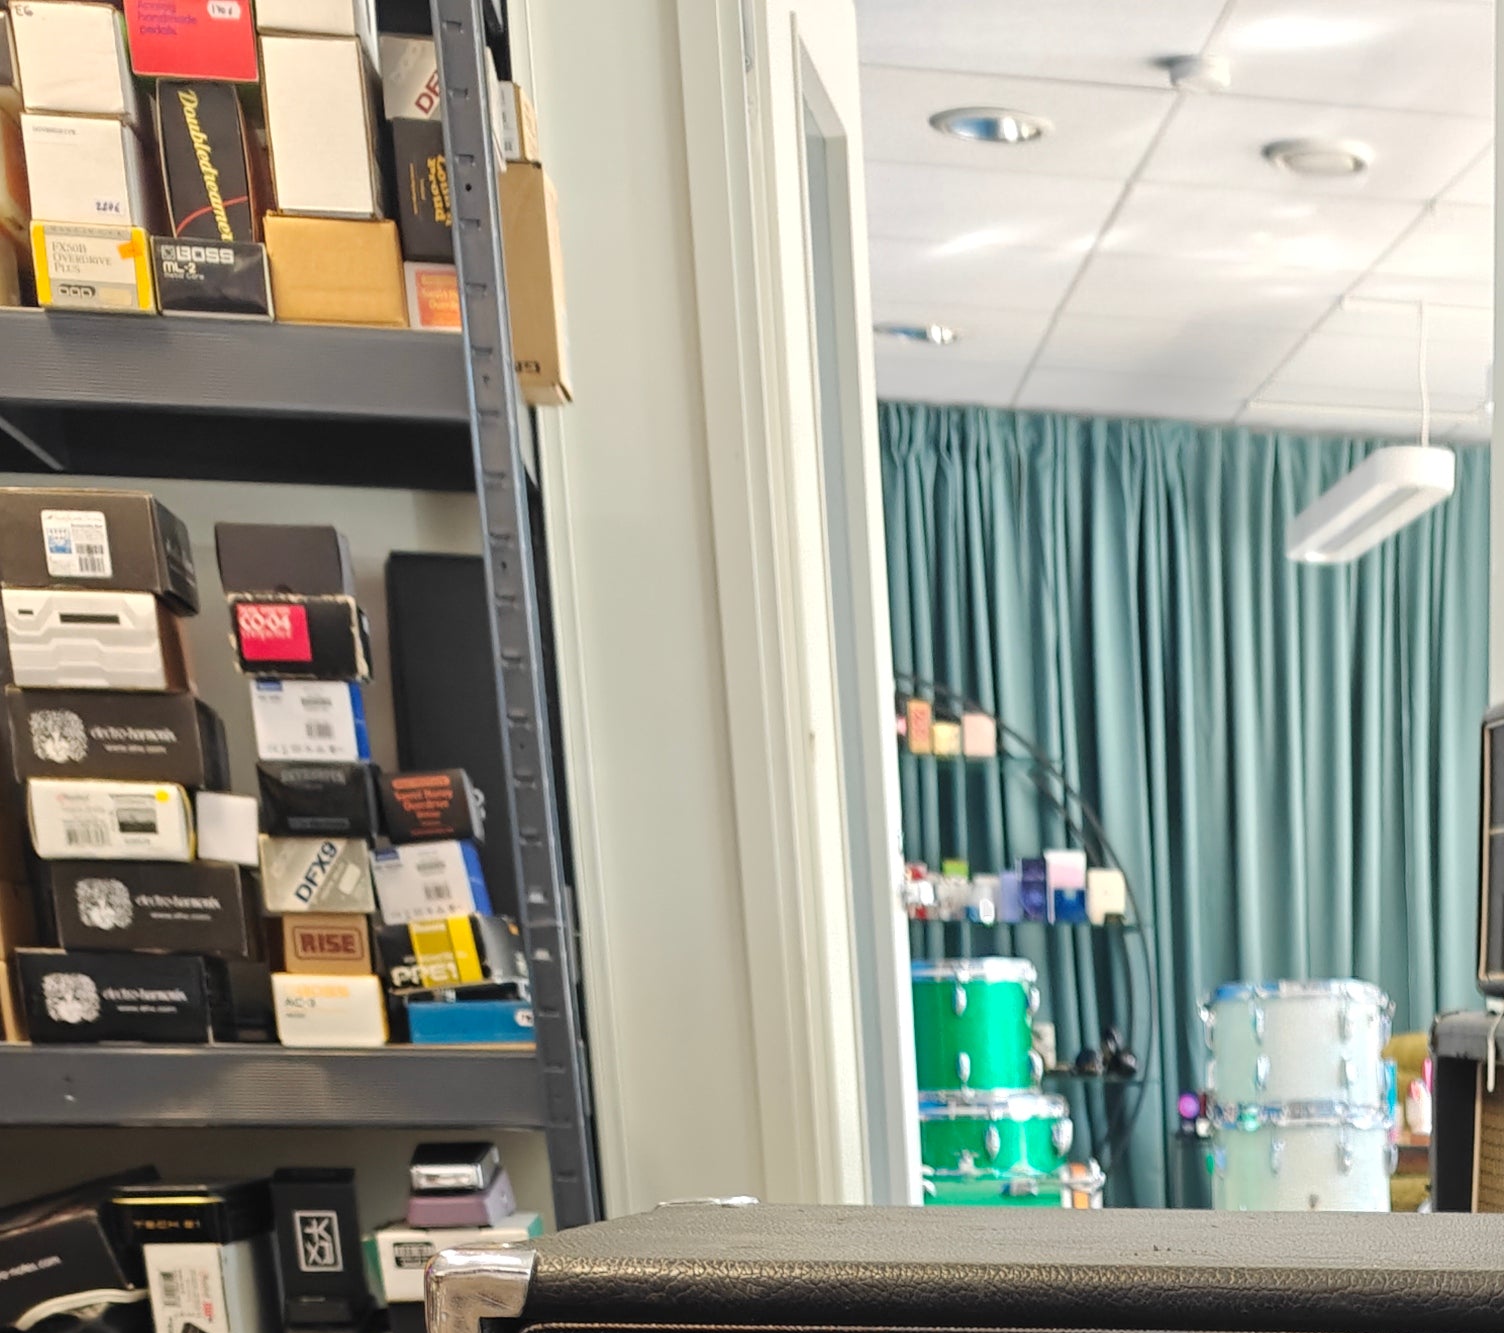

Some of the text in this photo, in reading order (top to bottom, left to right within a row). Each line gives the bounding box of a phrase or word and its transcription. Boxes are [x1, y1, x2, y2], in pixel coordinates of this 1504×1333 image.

[176, 88, 235, 243] Doubledreamer
[176, 245, 235, 265] BOSS
[162, 260, 197, 274] ML-2
[294, 840, 338, 904] DFX9
[300, 932, 356, 954] RISE
